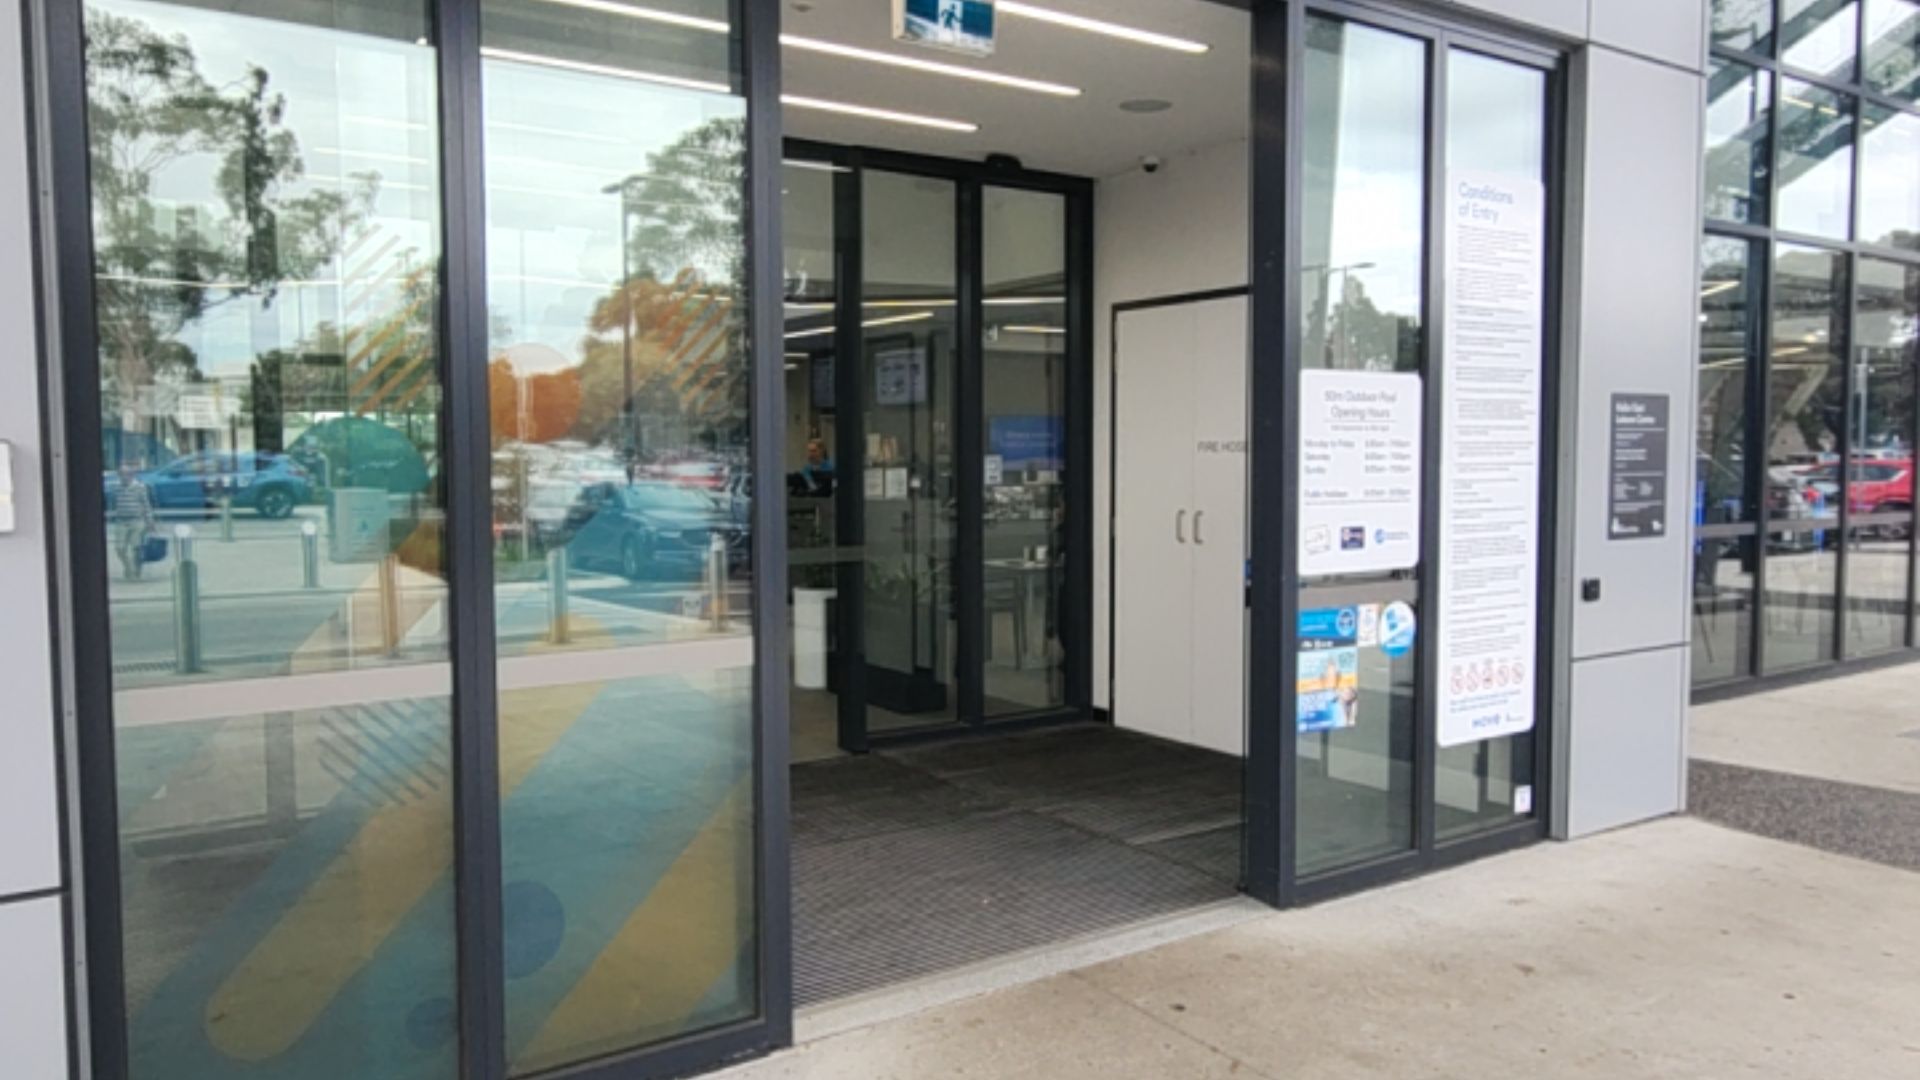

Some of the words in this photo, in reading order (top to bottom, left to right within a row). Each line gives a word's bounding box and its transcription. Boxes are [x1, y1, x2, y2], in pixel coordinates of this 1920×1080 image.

[1458, 181, 1513, 204] Conditions
[1458, 201, 1470, 217] of
[1472, 202, 1499, 224] Entry
[1331, 404, 1366, 420] Opening
[1367, 407, 1390, 418] Hours
[1197, 441, 1219, 452] FIRE
